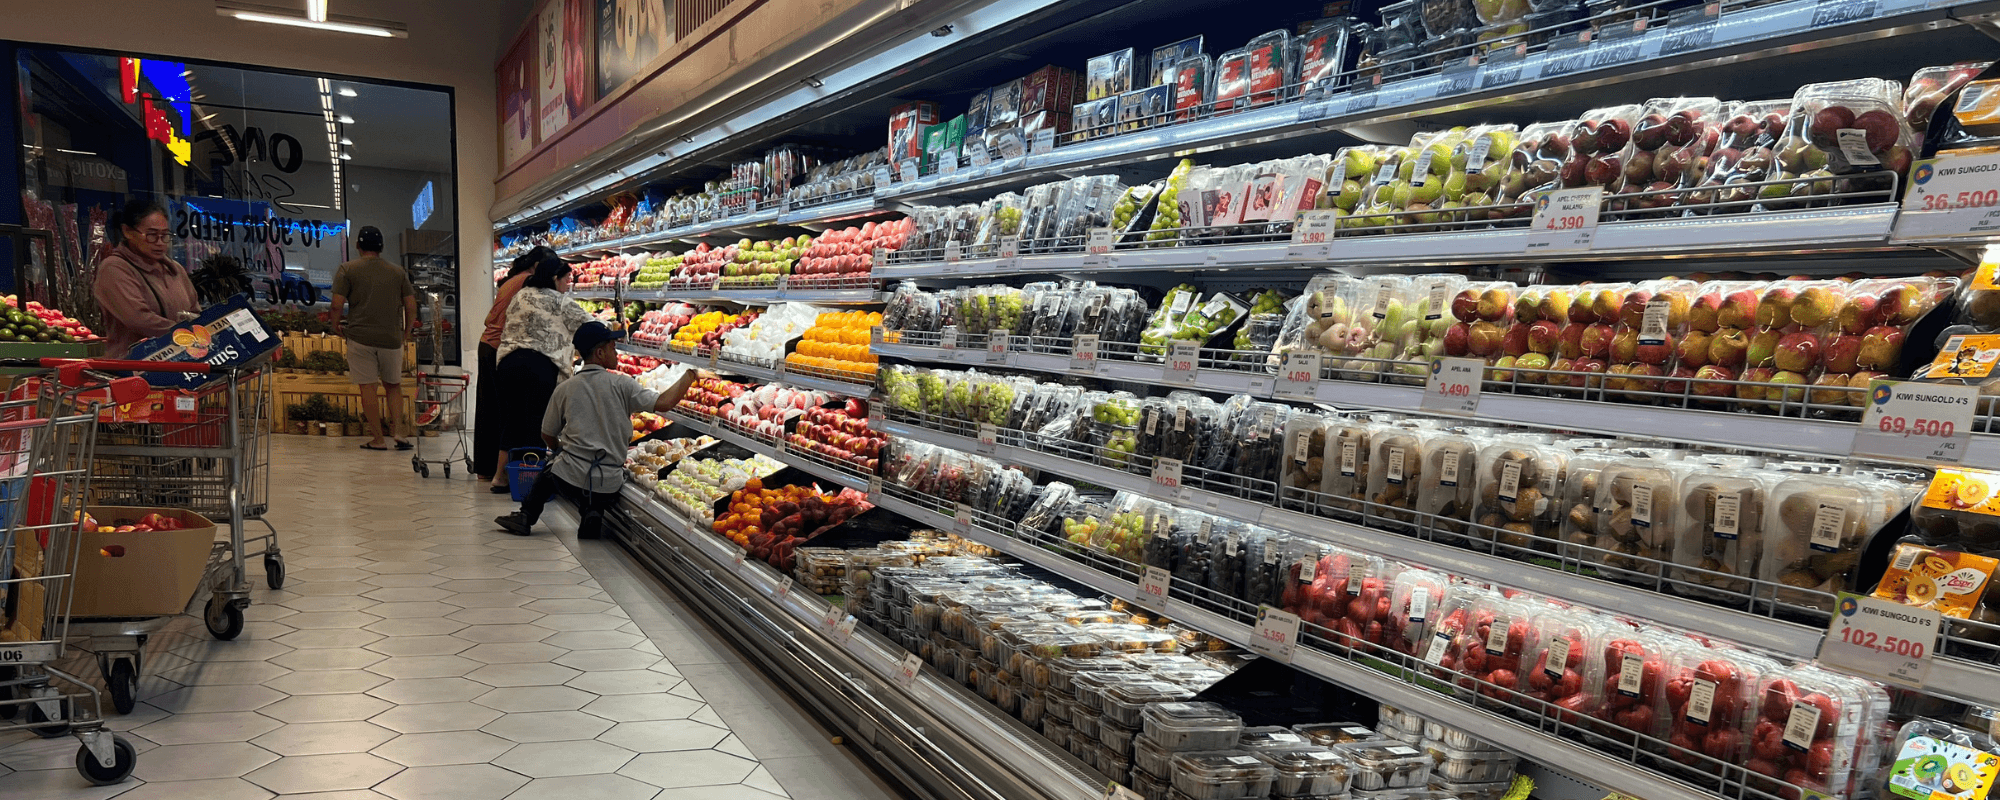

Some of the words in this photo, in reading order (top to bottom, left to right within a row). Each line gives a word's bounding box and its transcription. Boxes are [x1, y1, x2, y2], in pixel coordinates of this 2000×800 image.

[1667, 32, 1703, 50] 72.900
[1938, 168, 1956, 176] KIWI
[1958, 163, 1998, 175] SUNGOLD
[1921, 189, 1998, 214] 36,500
[1288, 370, 1311, 382] 4,050
[1439, 382, 1470, 397] 3,490
[1915, 394, 1955, 404] SUNGOLD
[1956, 397, 1968, 405] 4'S
[1879, 416, 1954, 438] 69,500
[1947, 575, 1975, 588] Zespri
[1862, 606, 1879, 616] KIWI
[1880, 610, 1918, 624] SUNGOLD
[1919, 618, 1931, 627] 6'S
[1841, 627, 1924, 659] 102,500
